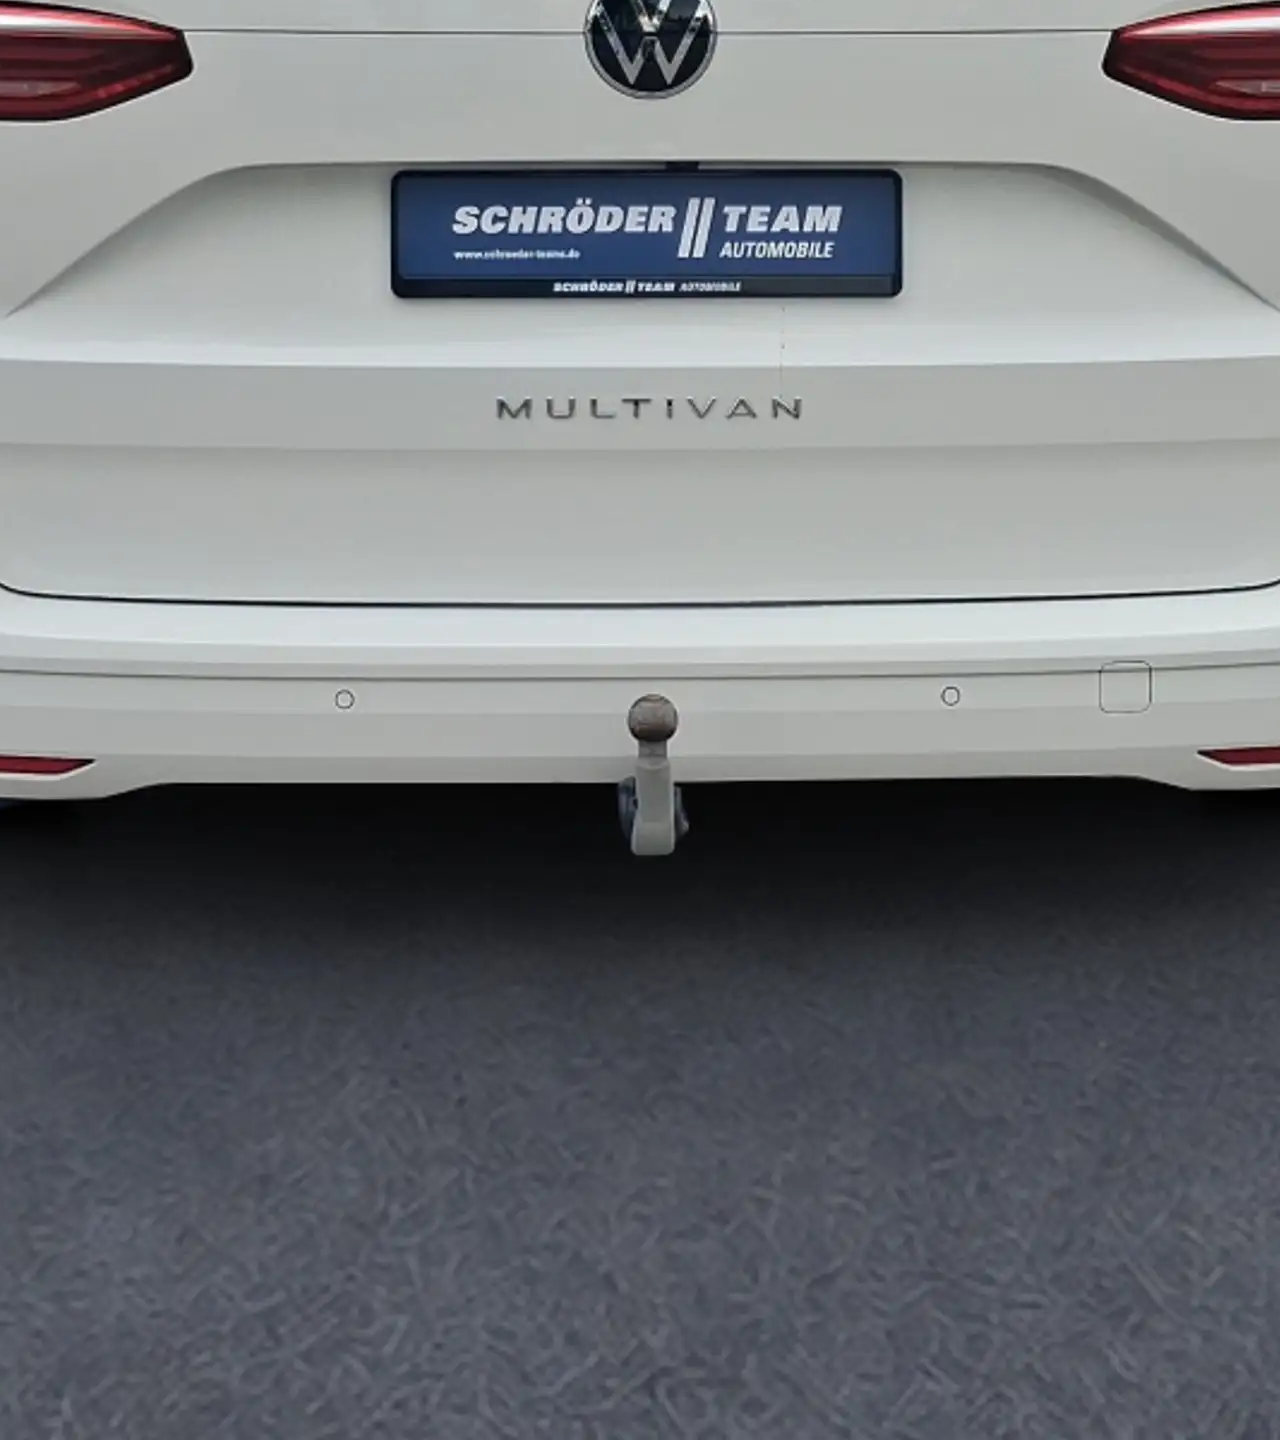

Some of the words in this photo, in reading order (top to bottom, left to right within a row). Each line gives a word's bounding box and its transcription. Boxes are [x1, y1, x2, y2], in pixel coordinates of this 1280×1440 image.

[452, 198, 677, 234] SCHRÖDER
[723, 205, 843, 233] TEAM
[719, 241, 835, 259] AUTOMOBILE
[637, 281, 676, 293] TEAM
[496, 397, 803, 420] MULTIVAN
